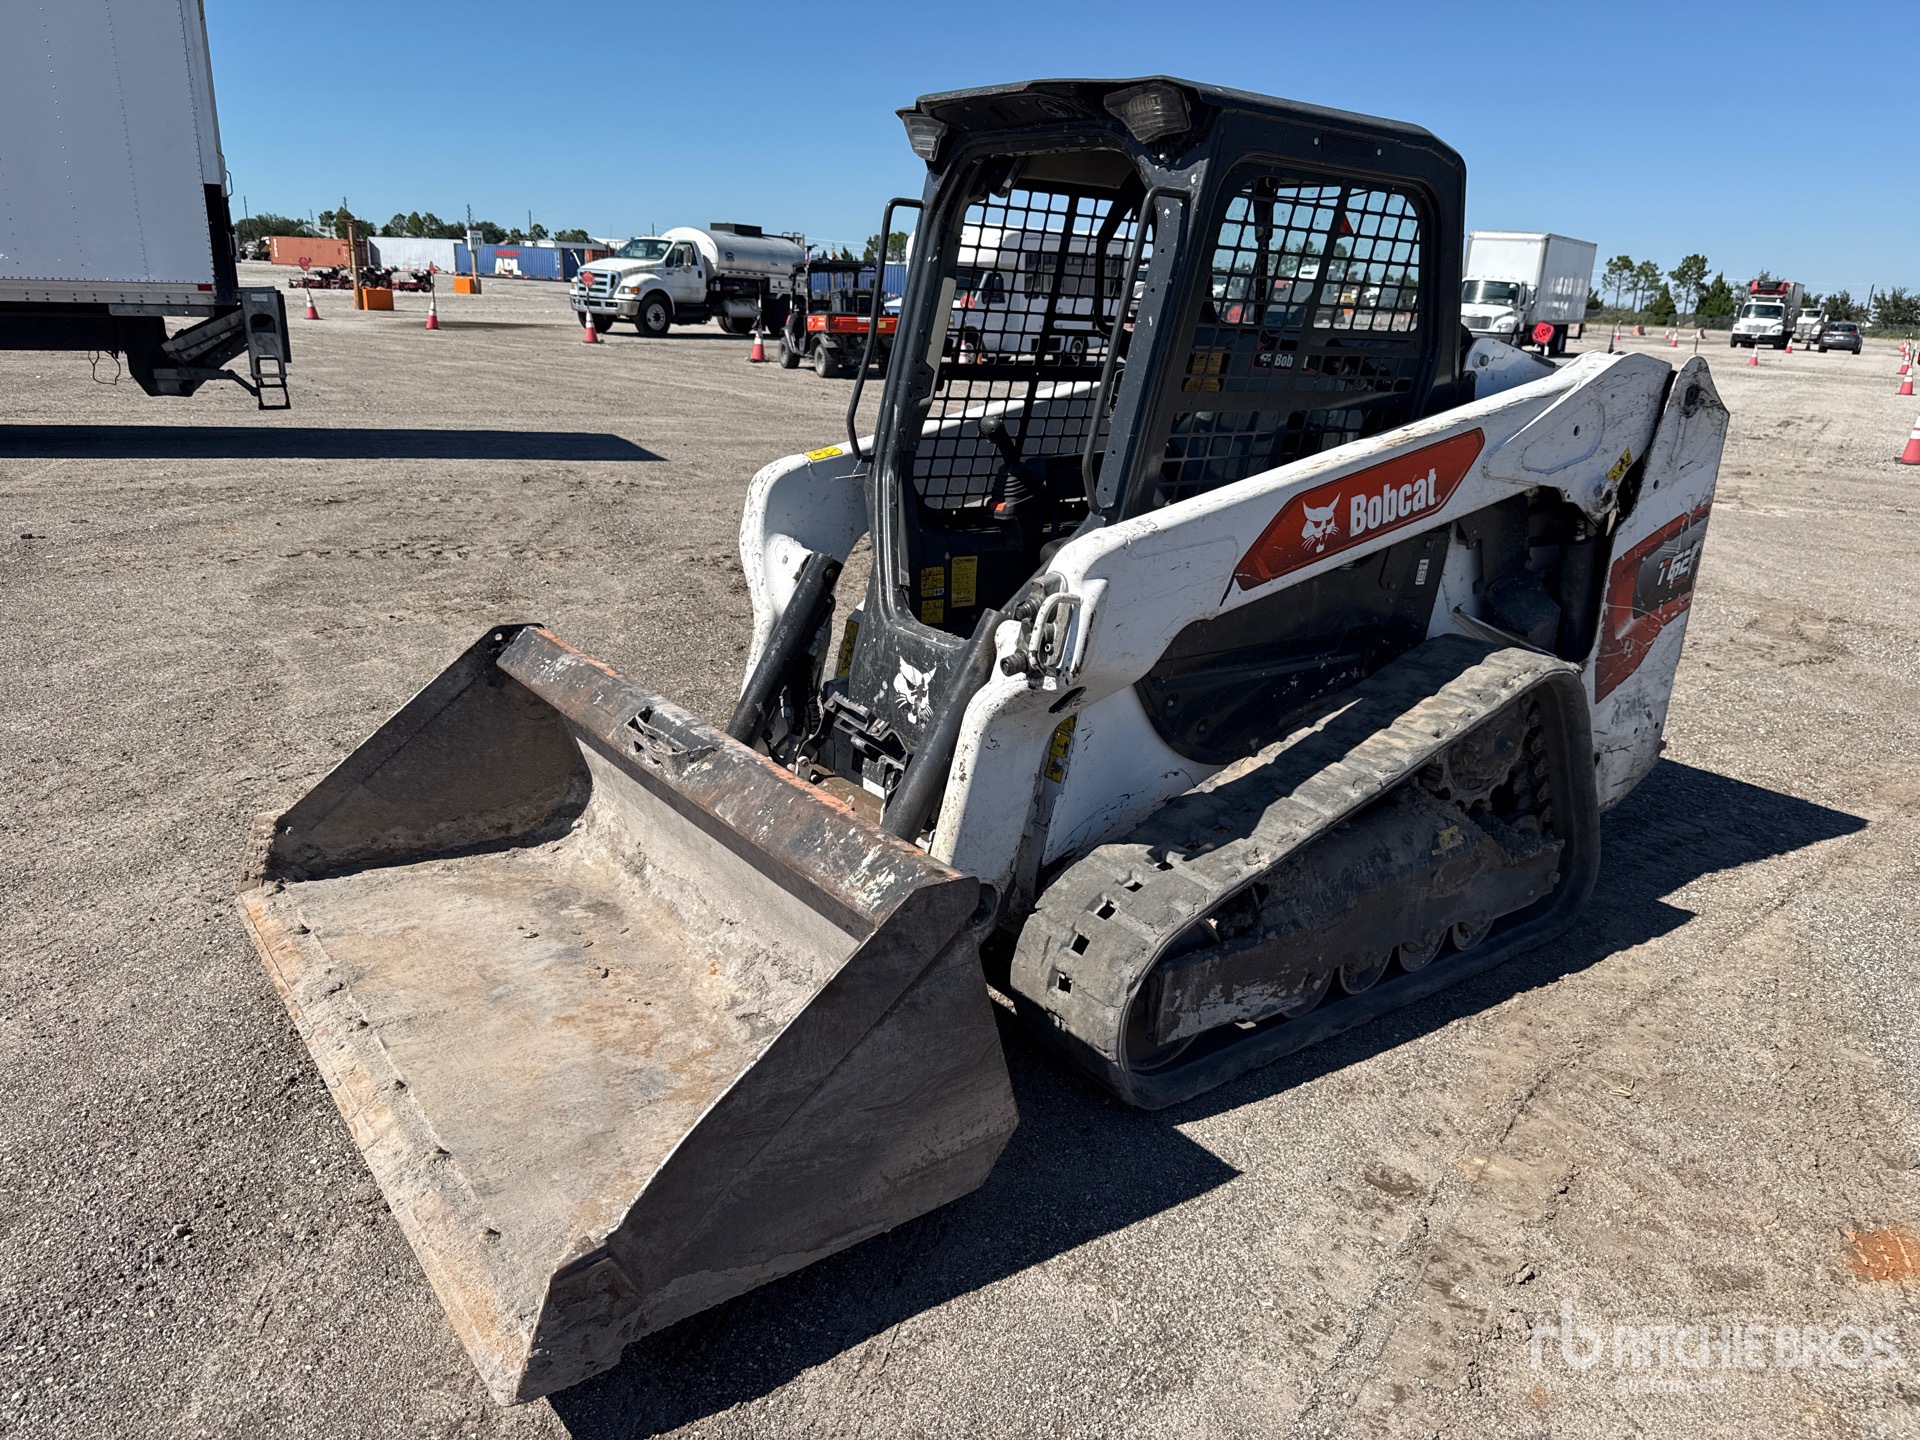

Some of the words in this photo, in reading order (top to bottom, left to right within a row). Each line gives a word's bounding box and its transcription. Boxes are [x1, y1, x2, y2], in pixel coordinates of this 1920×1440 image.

[495, 258, 522, 275] APL
[1534, 326, 1552, 340] SLOW
[1274, 353, 1309, 370] Bobt
[1350, 468, 1437, 537] Bobcat
